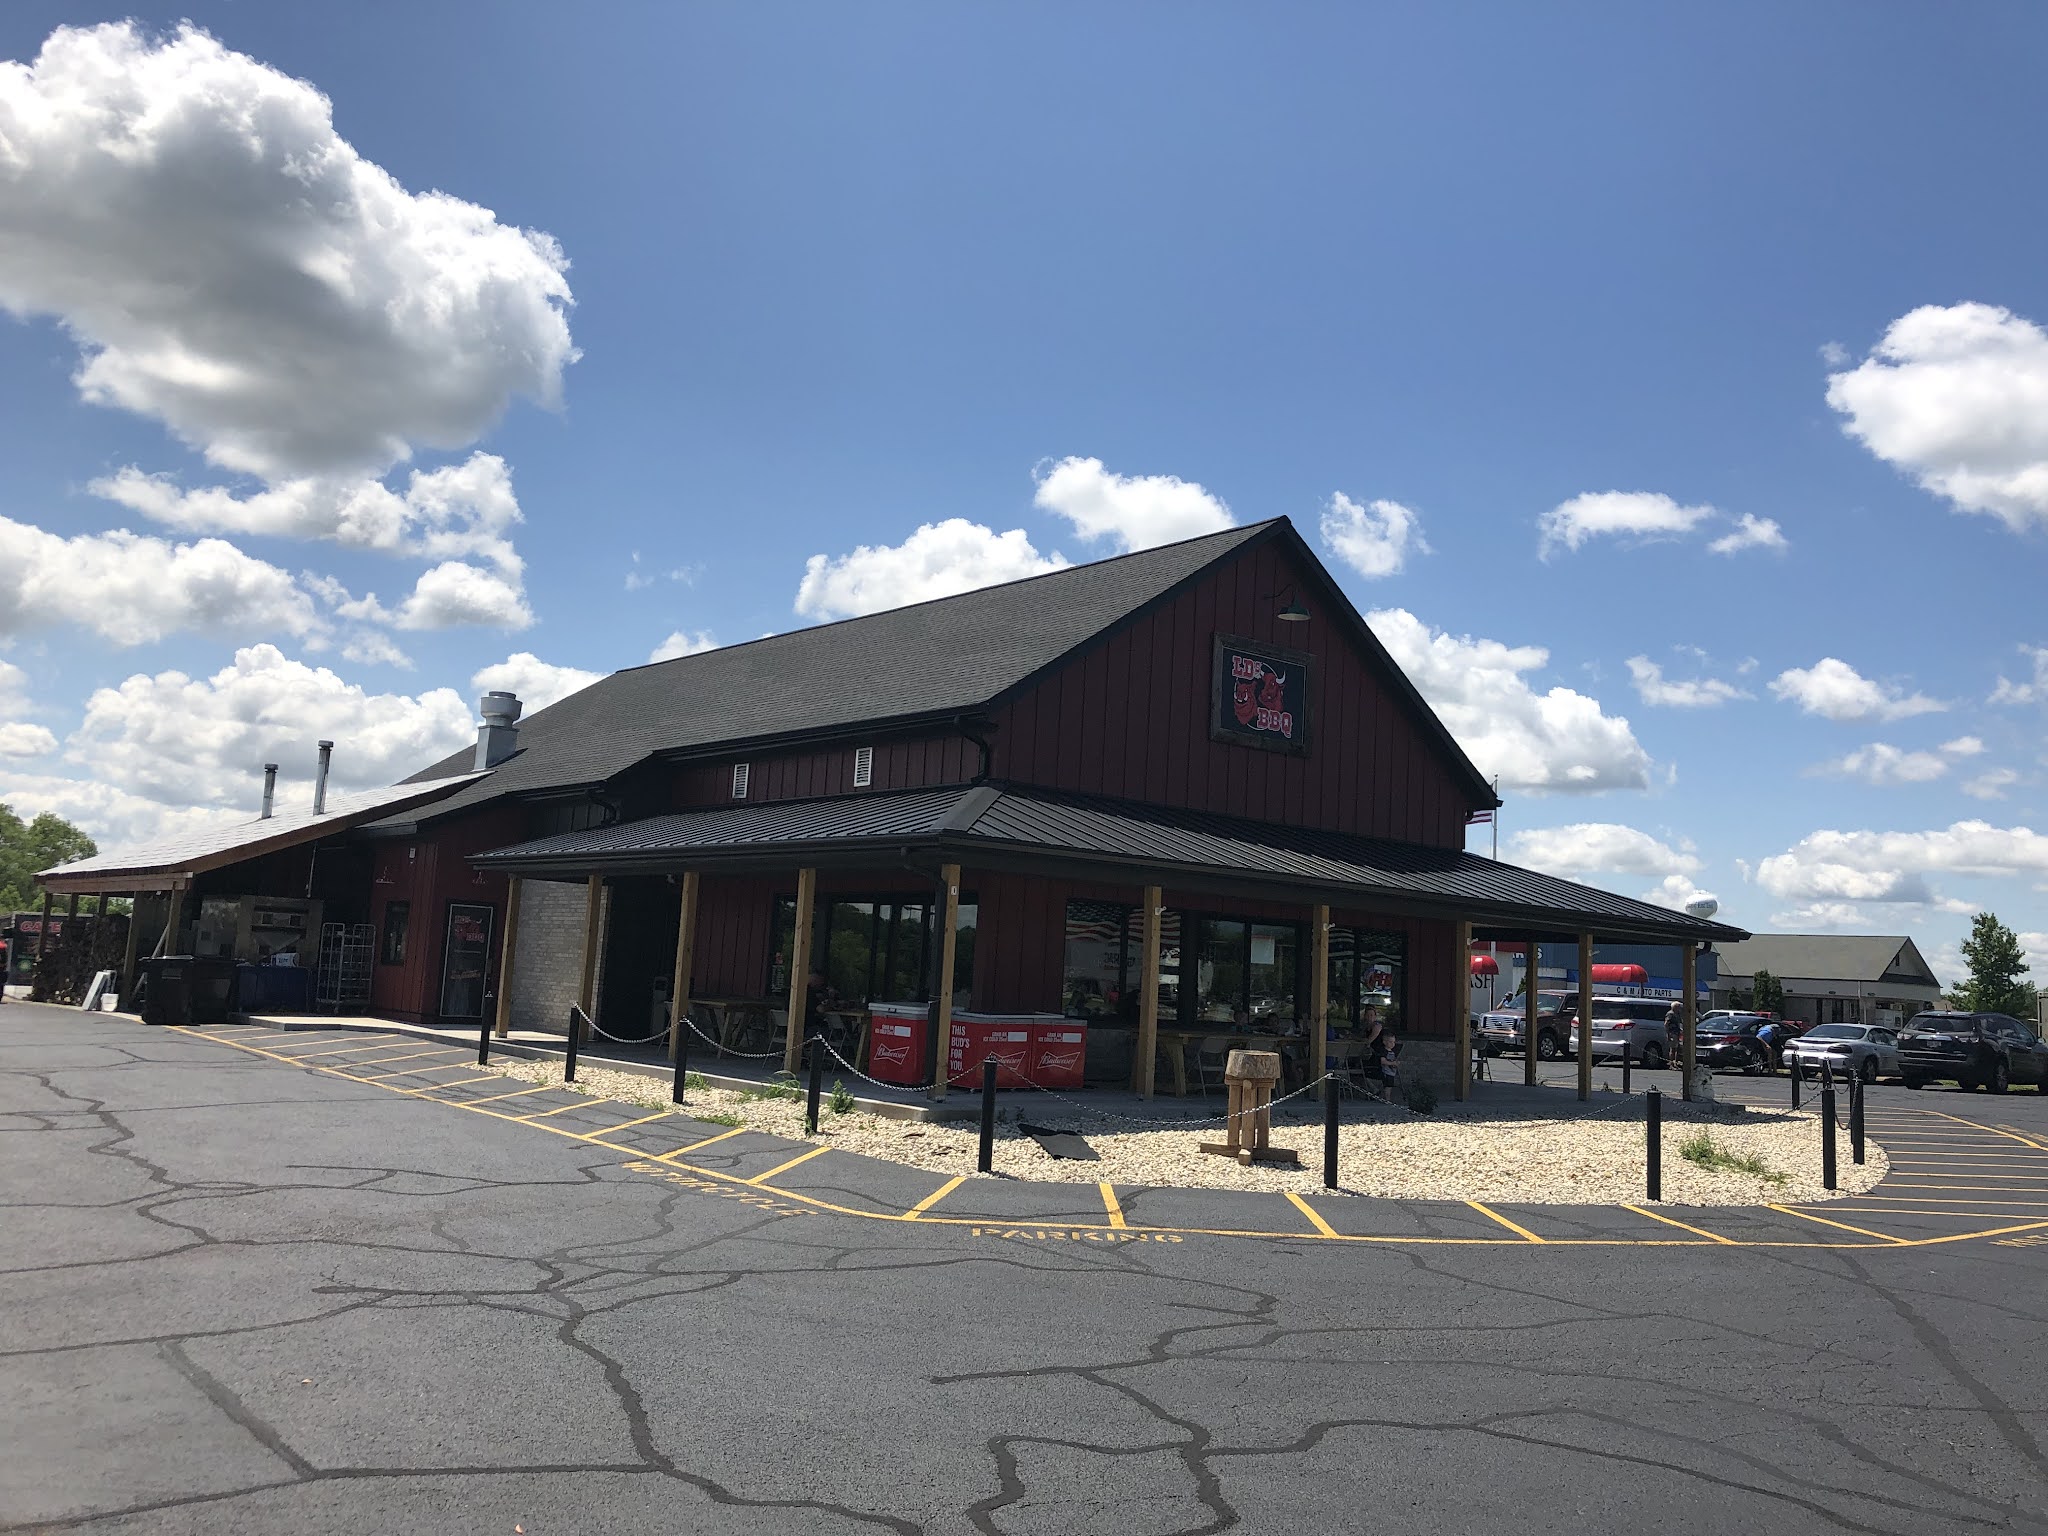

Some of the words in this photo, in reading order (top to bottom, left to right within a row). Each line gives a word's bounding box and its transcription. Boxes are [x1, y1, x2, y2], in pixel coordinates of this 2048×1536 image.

[1257, 707, 1293, 739] BBQ
[1654, 989, 1672, 997] PARTS
[951, 1025, 966, 1036] THIS
[951, 1036, 970, 1049] BUD'S
[877, 1046, 905, 1060] Budweiser
[950, 1048, 963, 1060] FOR
[1041, 1054, 1076, 1066] Budweiser
[621, 1162, 819, 1216] MOTORCYCLE
[971, 1227, 1184, 1243] PARKING
